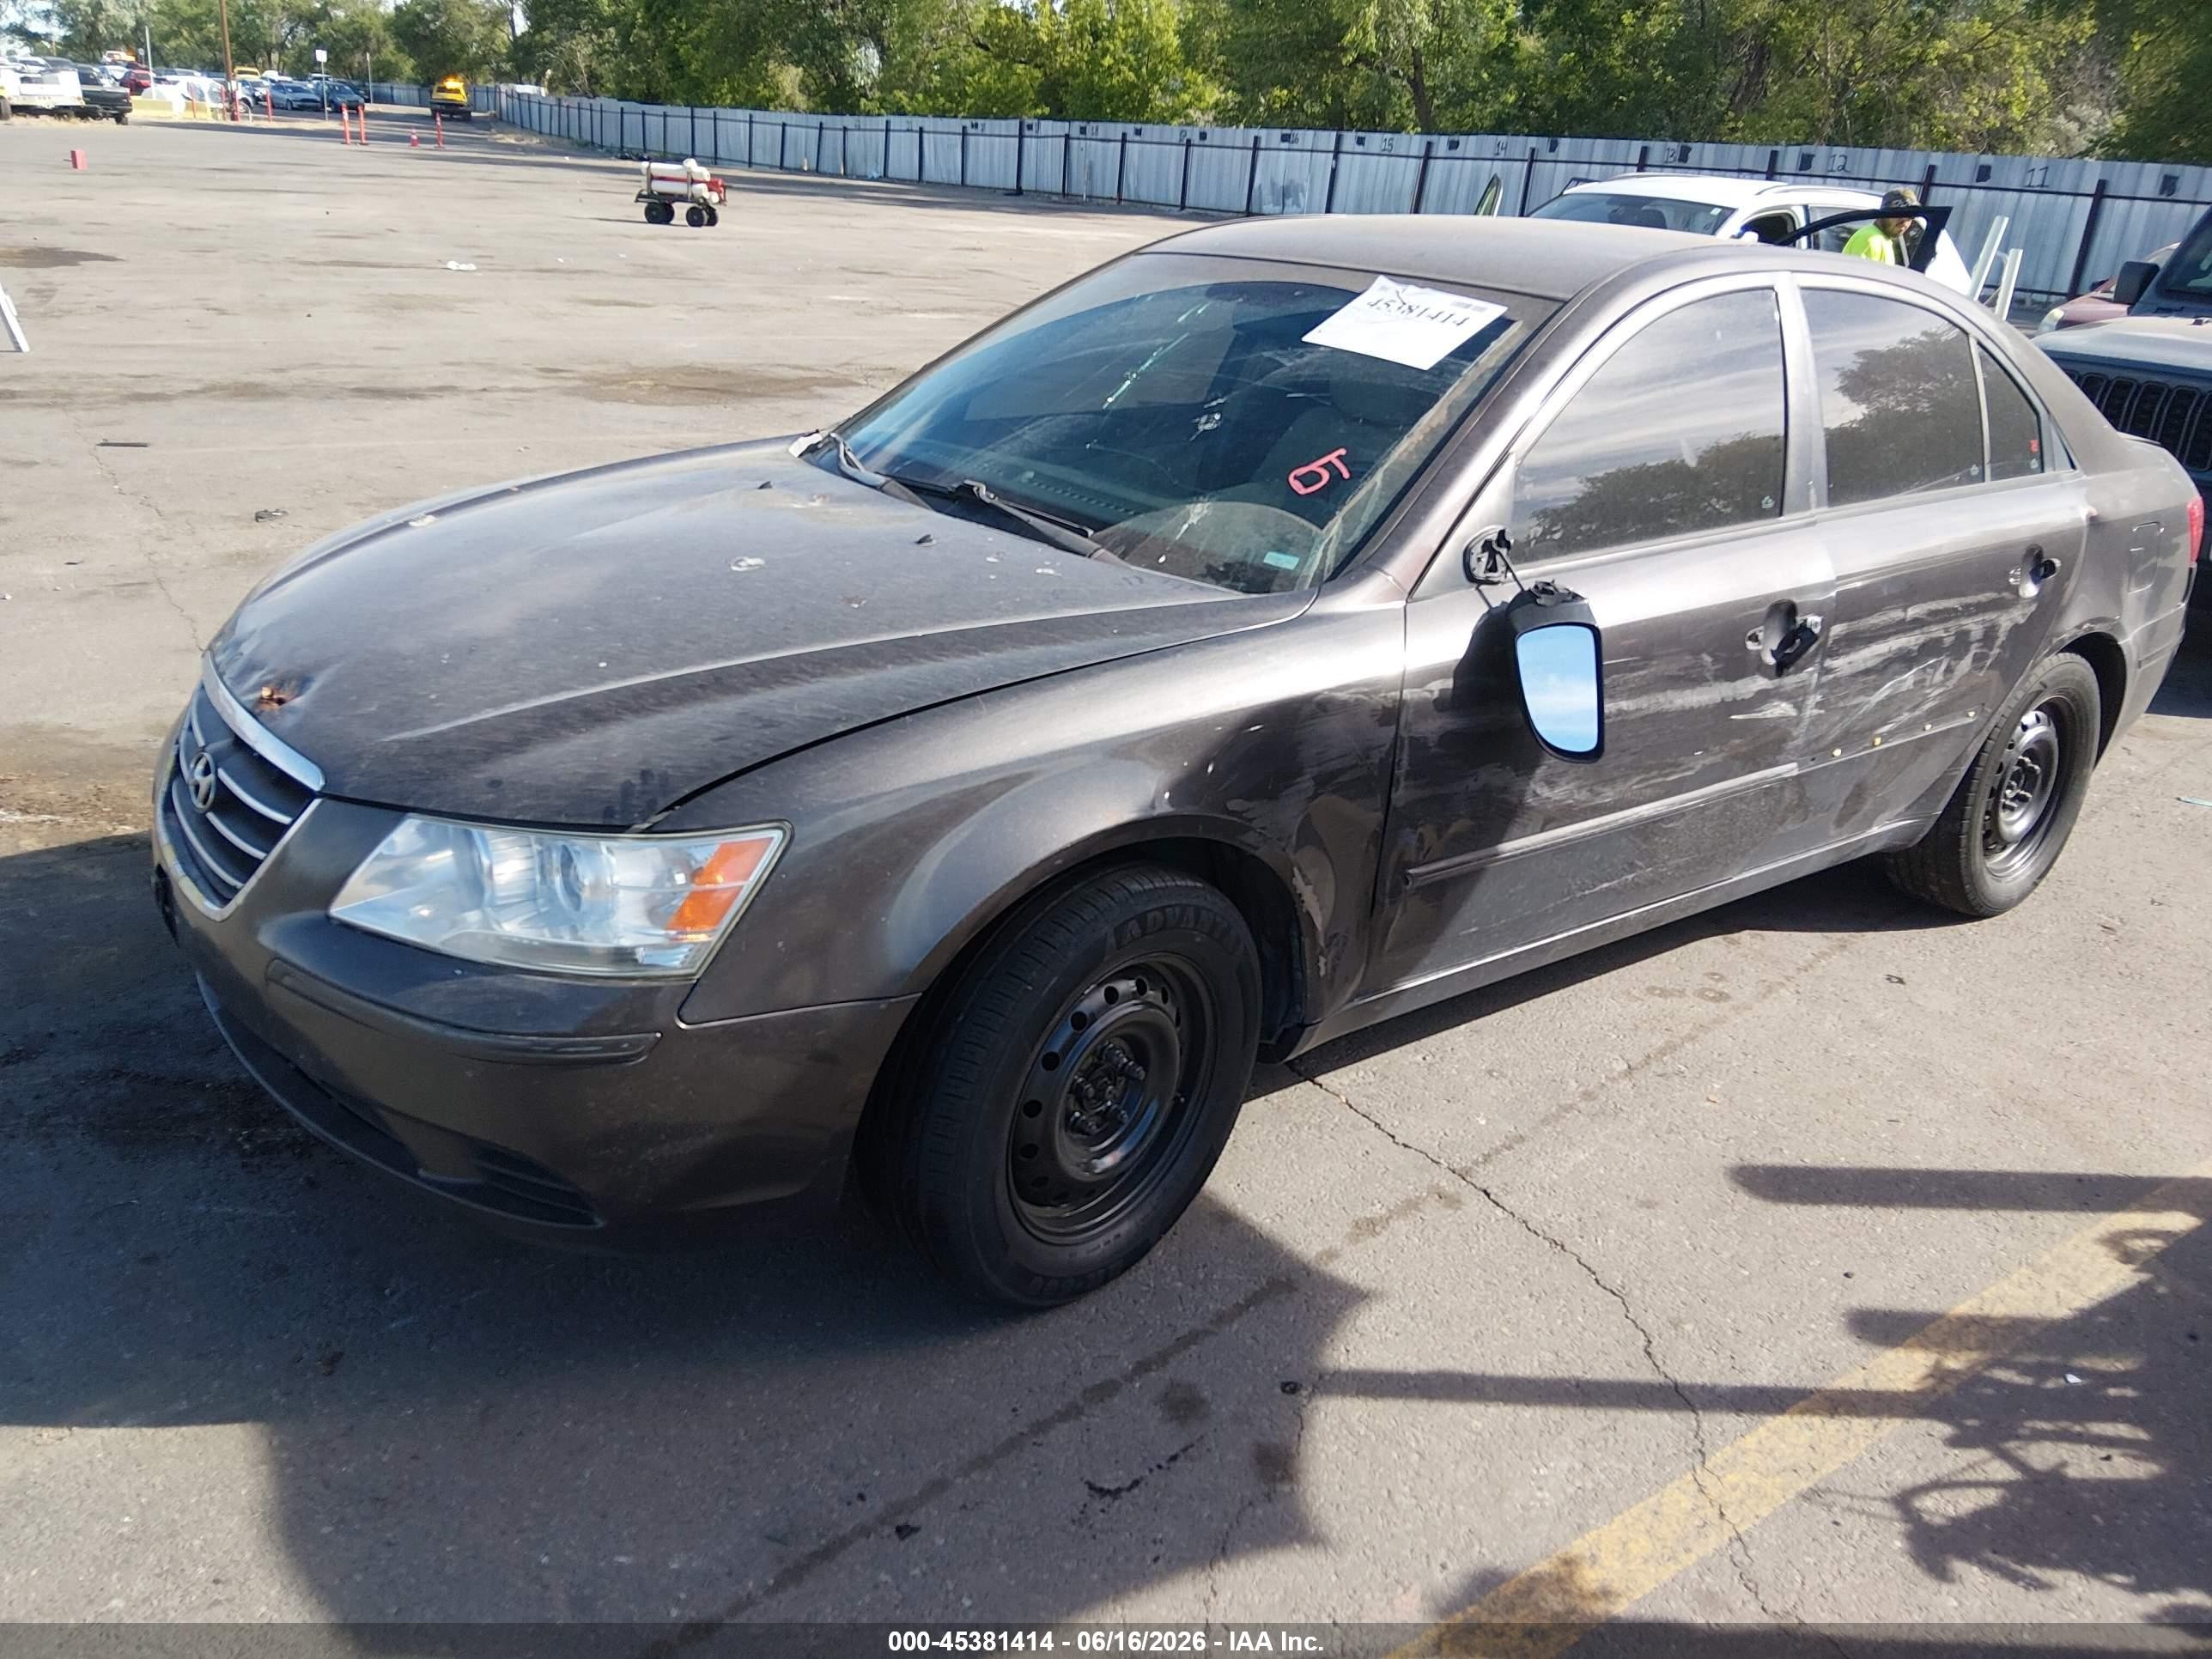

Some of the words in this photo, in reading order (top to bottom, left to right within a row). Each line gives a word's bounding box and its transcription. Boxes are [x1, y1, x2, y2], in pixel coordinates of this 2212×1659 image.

[1382, 137, 1395, 152] 15
[1494, 139, 1508, 156] 14
[1665, 147, 1678, 163] 13
[1826, 153, 1851, 173] 12
[2026, 166, 2050, 188] 11
